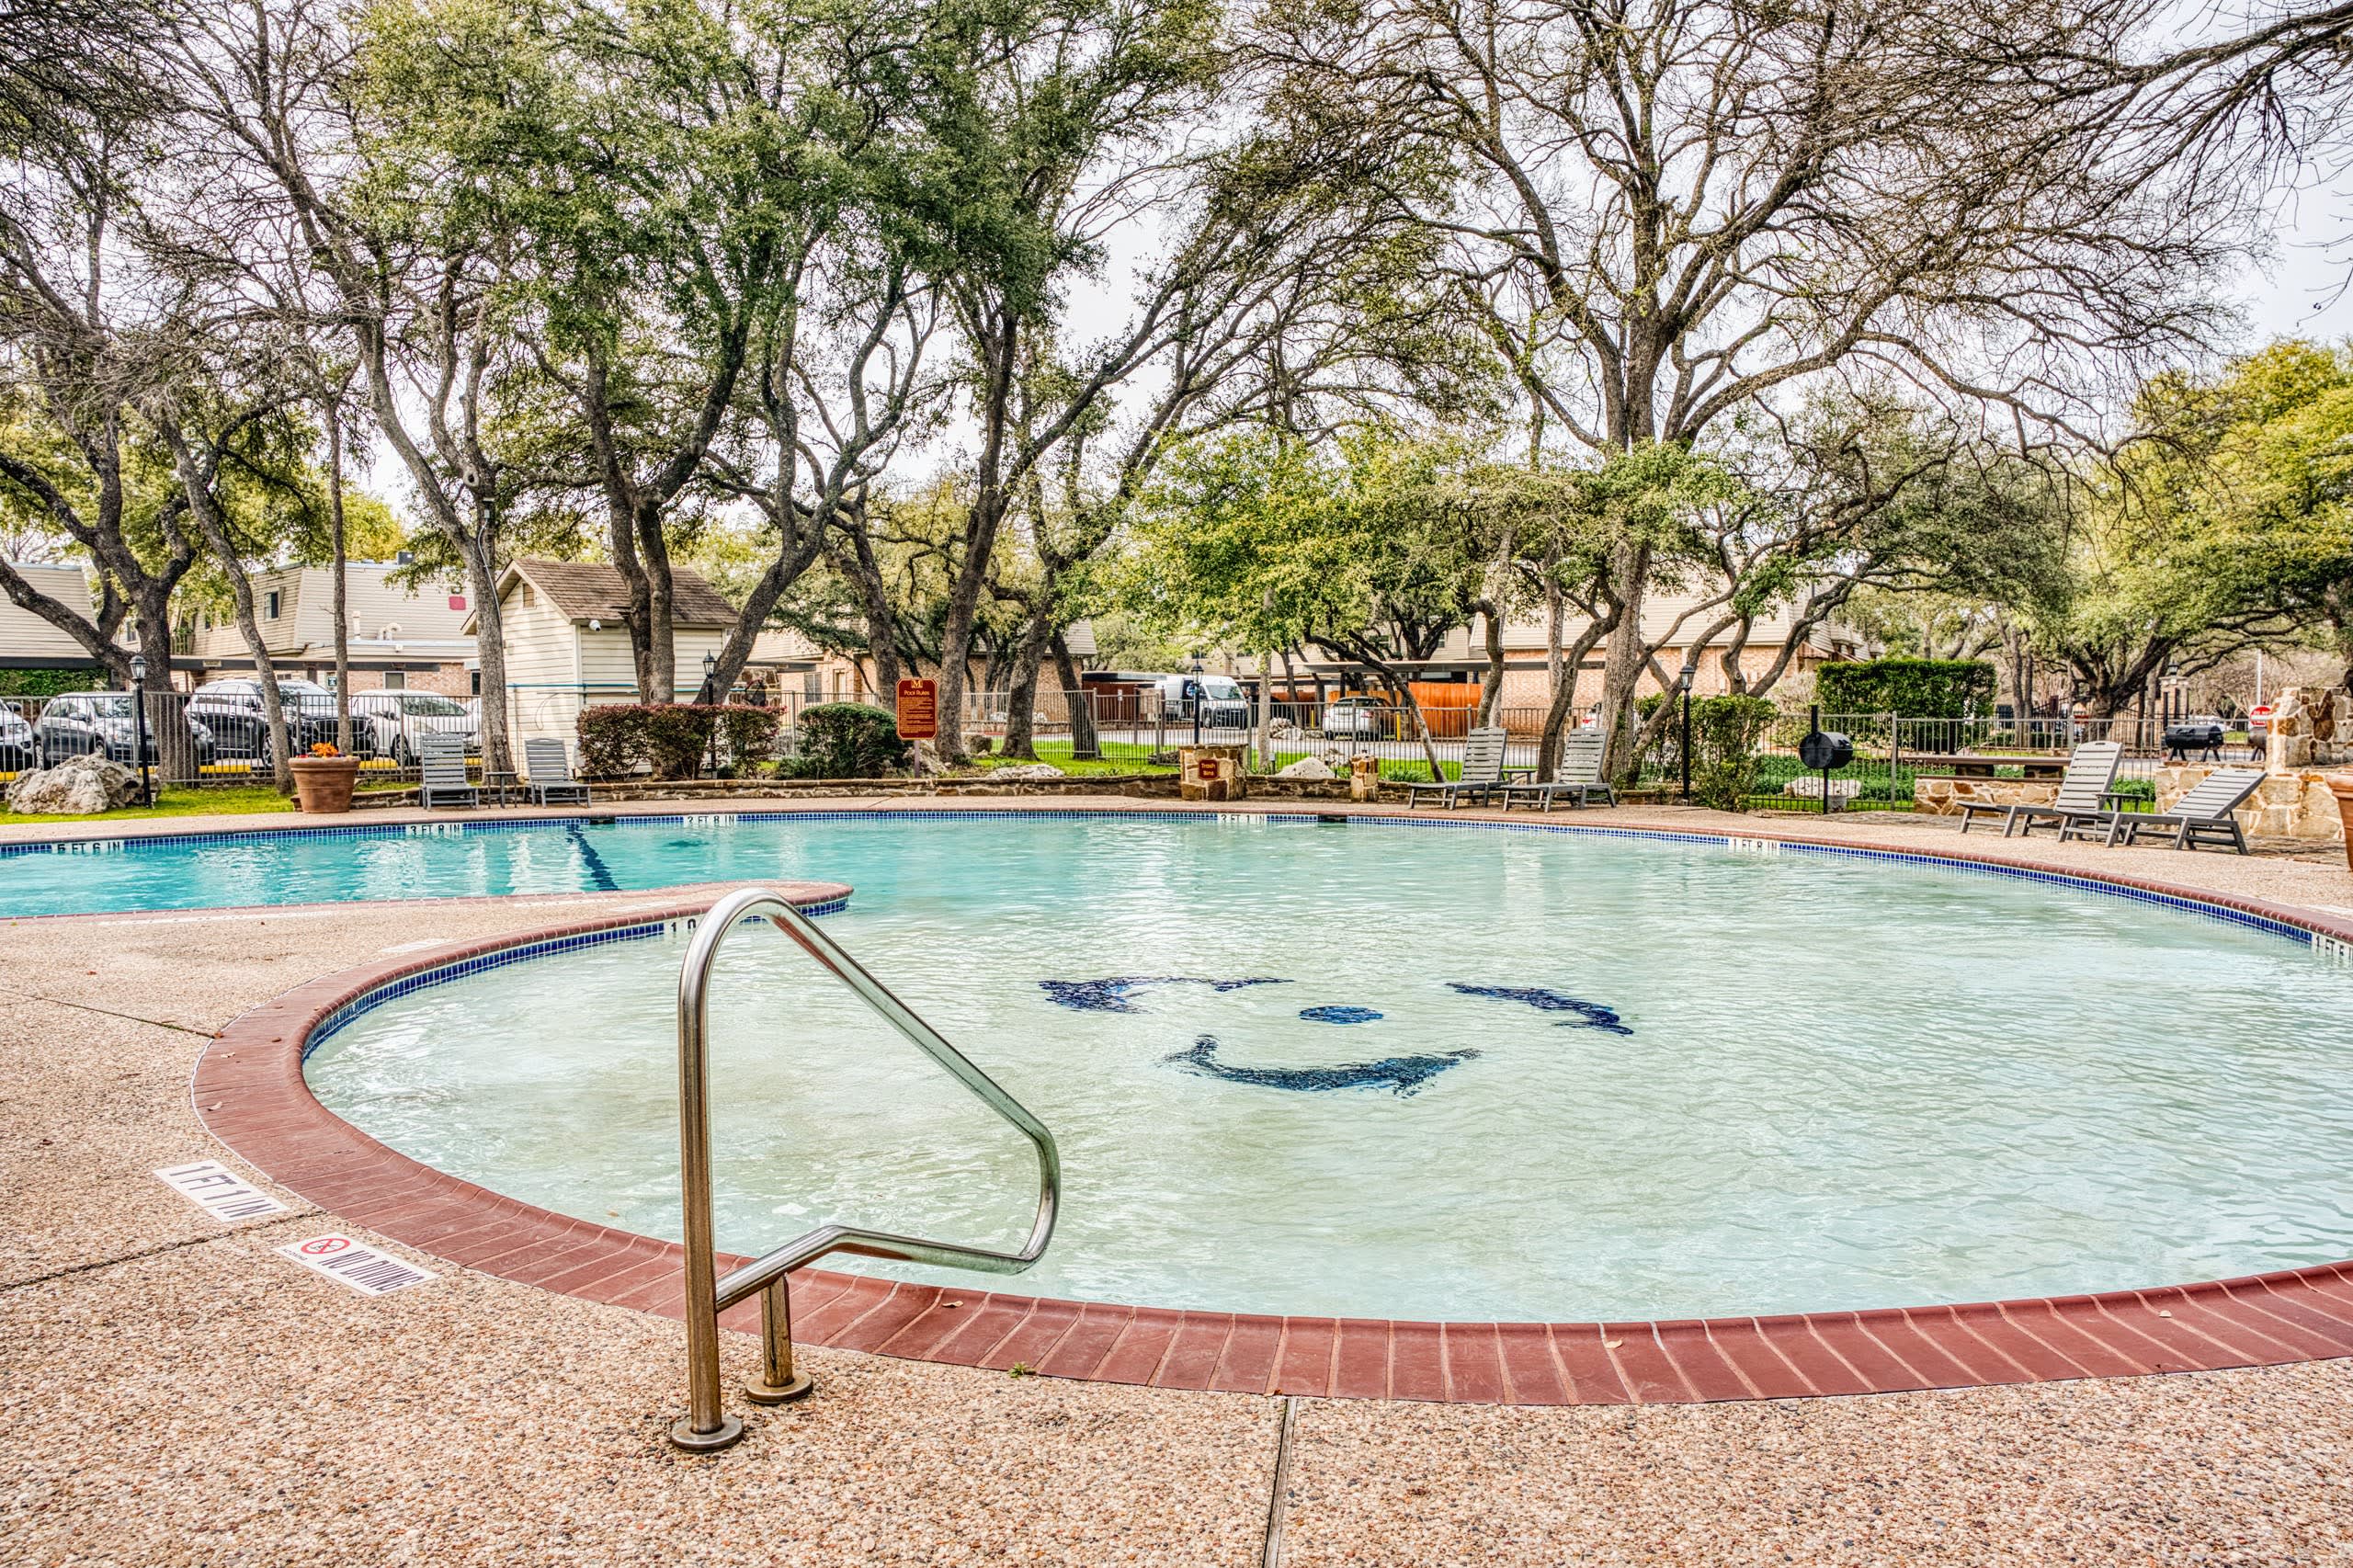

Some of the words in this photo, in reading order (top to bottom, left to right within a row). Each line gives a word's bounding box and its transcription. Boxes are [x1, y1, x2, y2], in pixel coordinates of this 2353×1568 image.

[699, 815, 709, 824] FT
[724, 814, 734, 824] IN
[1231, 813, 1241, 824] FT
[1256, 815, 1265, 824] IN
[422, 824, 433, 835] FT
[449, 824, 460, 834] IN
[72, 842, 86, 855] FT
[108, 840, 120, 855] IN
[1742, 838, 1752, 850] FT
[1768, 841, 1777, 852] IN
[2325, 938, 2336, 955] FT
[169, 1165, 215, 1176] 1
[178, 1174, 238, 1191] FT
[203, 1189, 251, 1201] 1
[217, 1199, 278, 1218] IN
[317, 1250, 375, 1269] NO
[340, 1259, 425, 1292] DIVING
